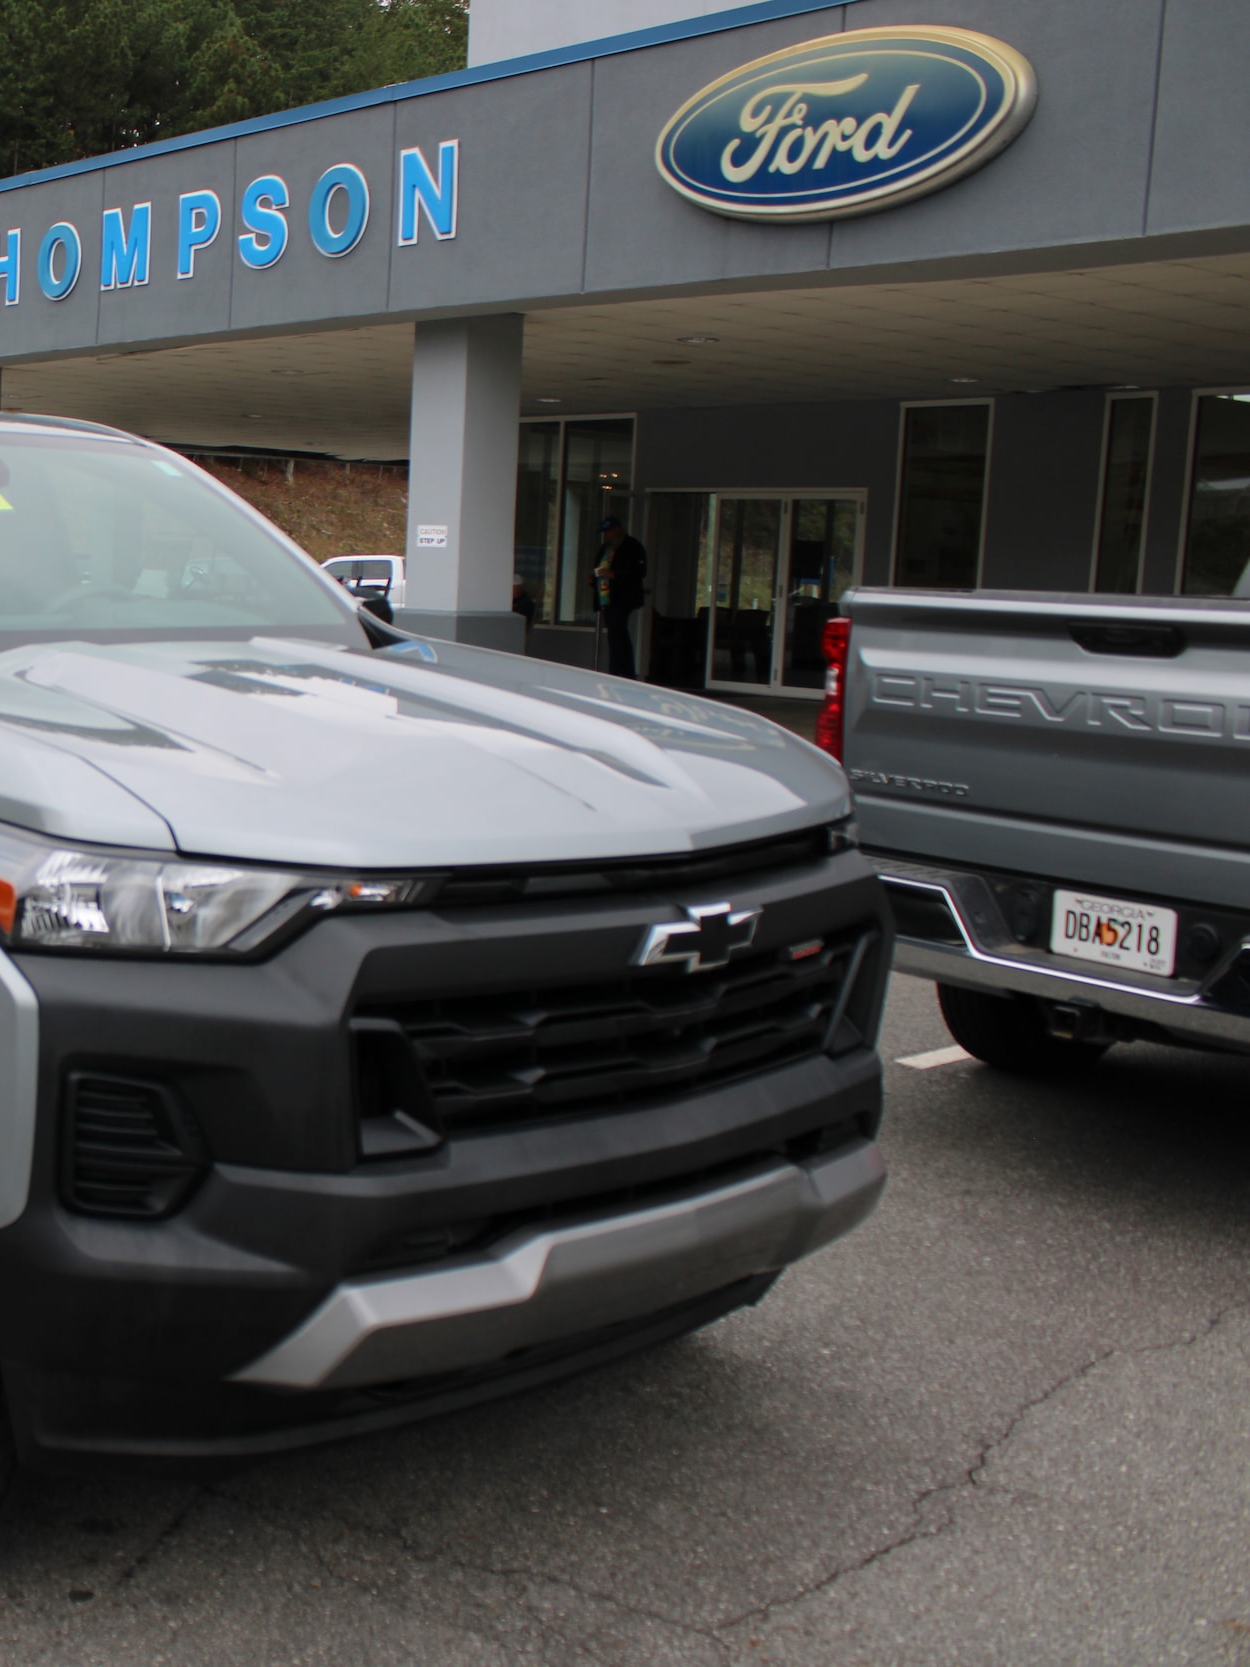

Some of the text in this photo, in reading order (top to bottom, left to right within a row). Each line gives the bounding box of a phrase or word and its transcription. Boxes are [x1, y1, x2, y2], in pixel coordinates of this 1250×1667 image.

[720, 73, 921, 184] Ford
[849, 766, 970, 796] SILVERADO
[1079, 898, 1147, 921] GEORGIA
[1064, 909, 1160, 956] DBA5218
